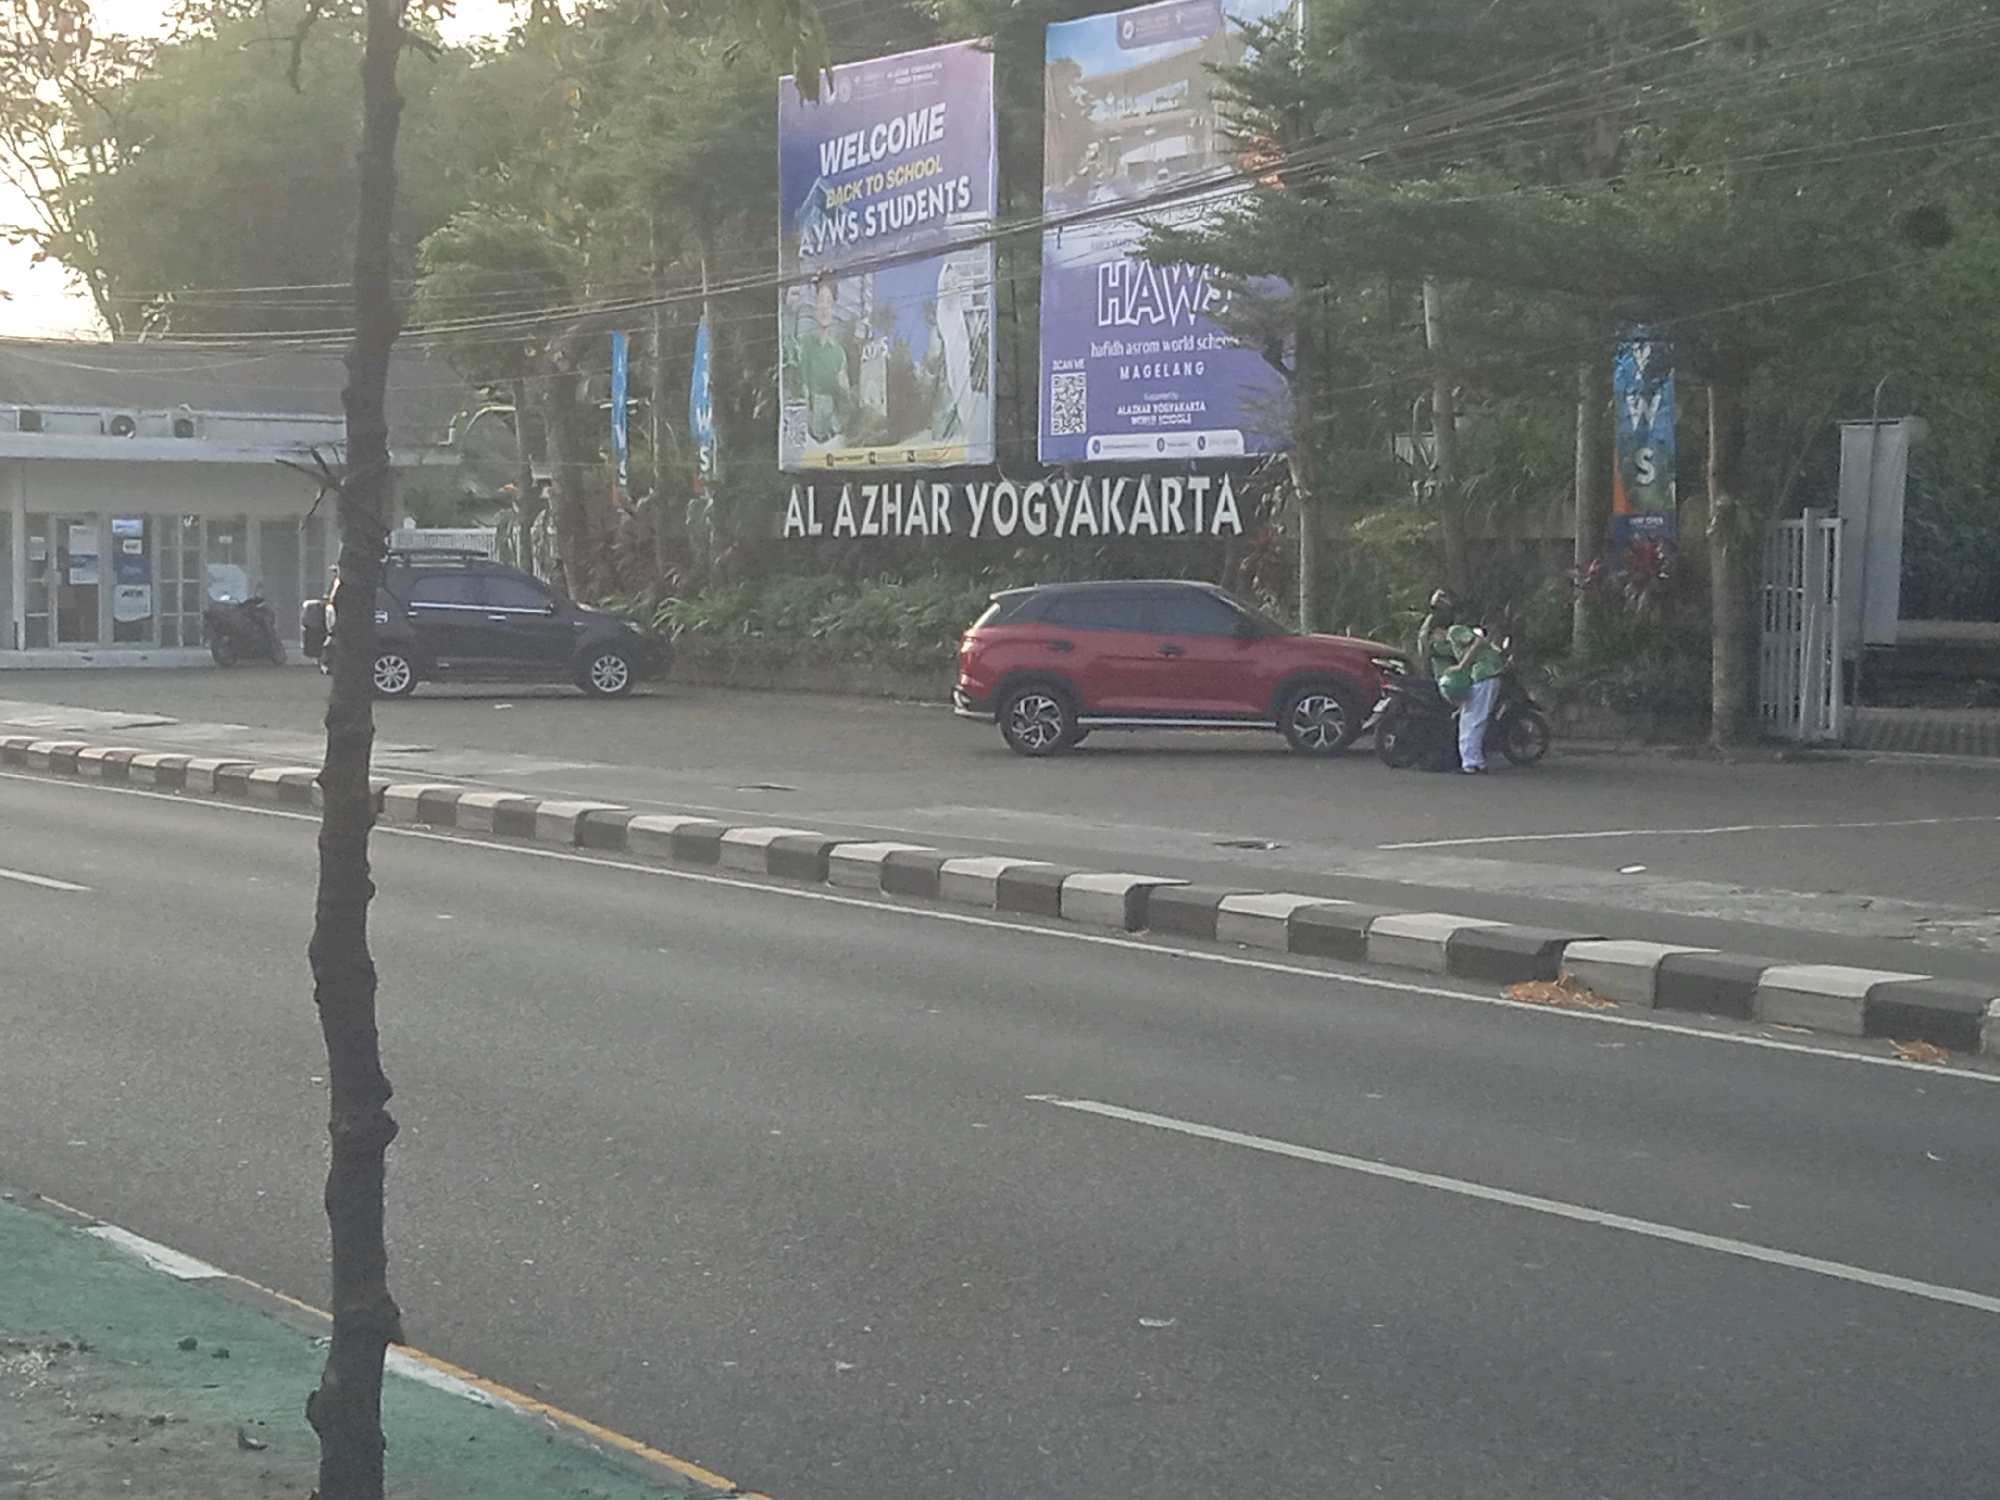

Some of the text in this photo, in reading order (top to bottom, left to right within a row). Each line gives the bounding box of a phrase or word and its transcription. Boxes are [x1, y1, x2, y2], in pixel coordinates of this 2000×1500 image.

[820, 102, 946, 177] WELCOME
[825, 154, 943, 209] BACK TO SCHOOL
[798, 208, 859, 258] AYWS
[865, 175, 970, 237] STUDENTS
[1091, 340, 1124, 358] hafidh
[1126, 341, 1160, 356] asrom
[1162, 334, 1193, 352] world
[1119, 361, 1205, 381] MAGELANG
[783, 475, 1243, 539] AL AZHAR YOGYAKARTA
